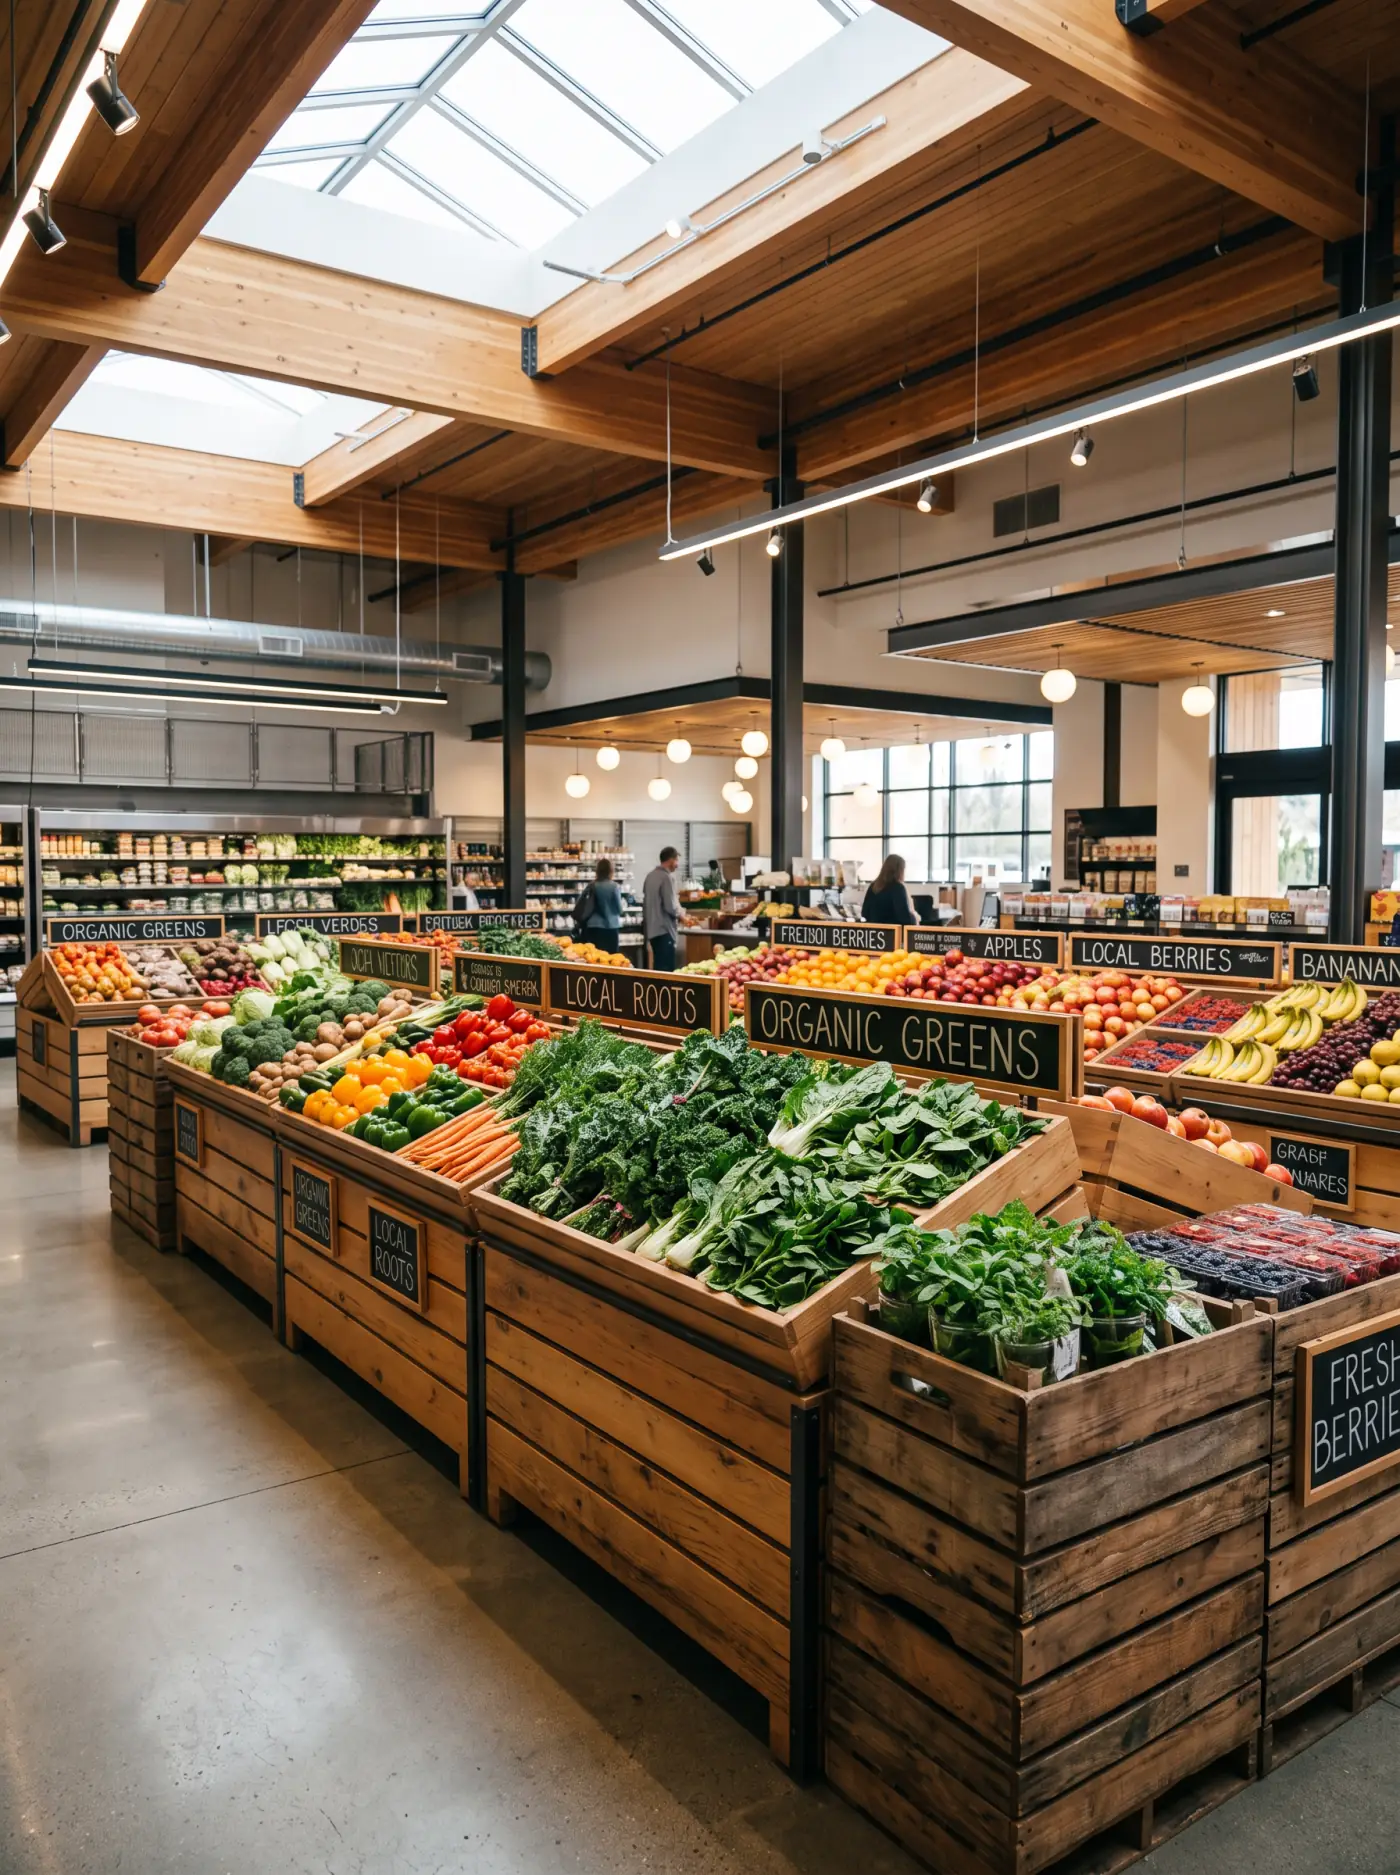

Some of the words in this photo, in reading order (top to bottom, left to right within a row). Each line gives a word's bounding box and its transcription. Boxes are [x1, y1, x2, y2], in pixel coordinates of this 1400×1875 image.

[62, 922, 136, 940] ORGANIC
[142, 921, 206, 938] GREENS
[832, 928, 886, 950] BERRIES
[984, 936, 1042, 960] APPLES
[1082, 941, 1139, 966] LOCAL
[1151, 945, 1232, 973] BERRIES
[566, 974, 623, 1013] LOCAL
[633, 982, 697, 1024] ROOTS
[760, 998, 884, 1055] ORGANIC
[901, 1015, 1040, 1080] GREENS
[296, 1201, 330, 1240] GREENS
[375, 1215, 413, 1256] LOCAL
[375, 1245, 414, 1291] ROOTS
